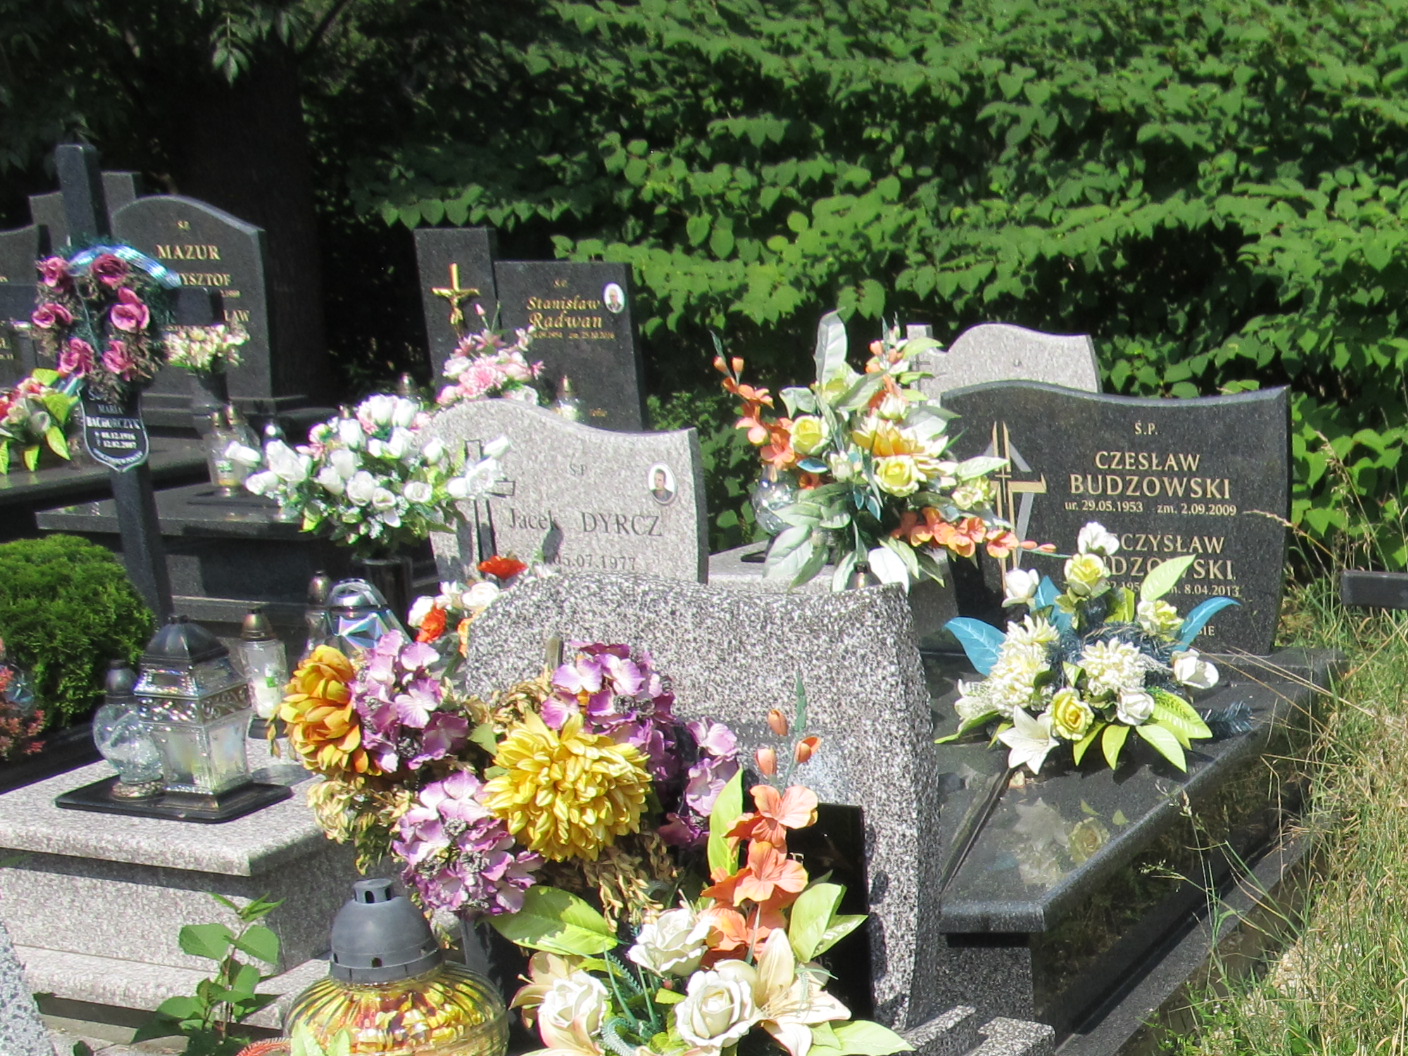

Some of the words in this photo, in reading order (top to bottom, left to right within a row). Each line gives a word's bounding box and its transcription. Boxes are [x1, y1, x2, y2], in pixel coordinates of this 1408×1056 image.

[156, 244, 221, 260] MAZUR
[179, 273, 231, 287] YSZTOF
[526, 294, 600, 311] Stanisław
[528, 310, 603, 330] Radwan
[1134, 420, 1159, 435] Ś.P.
[1095, 450, 1200, 471] CZESŁAW
[1069, 473, 1230, 500] BUDZOWSKI
[1064, 501, 1079, 512] ur.
[1081, 500, 1144, 513] 29.05.1953
[1157, 503, 1178, 514] zm.
[508, 507, 558, 530] Jacek
[580, 511, 663, 537] DYRCZ
[1112, 533, 1225, 554] CZYSŁAW
[553, 553, 636, 571] 05.07.1977
[1183, 583, 1239, 597] 8.04.2013
